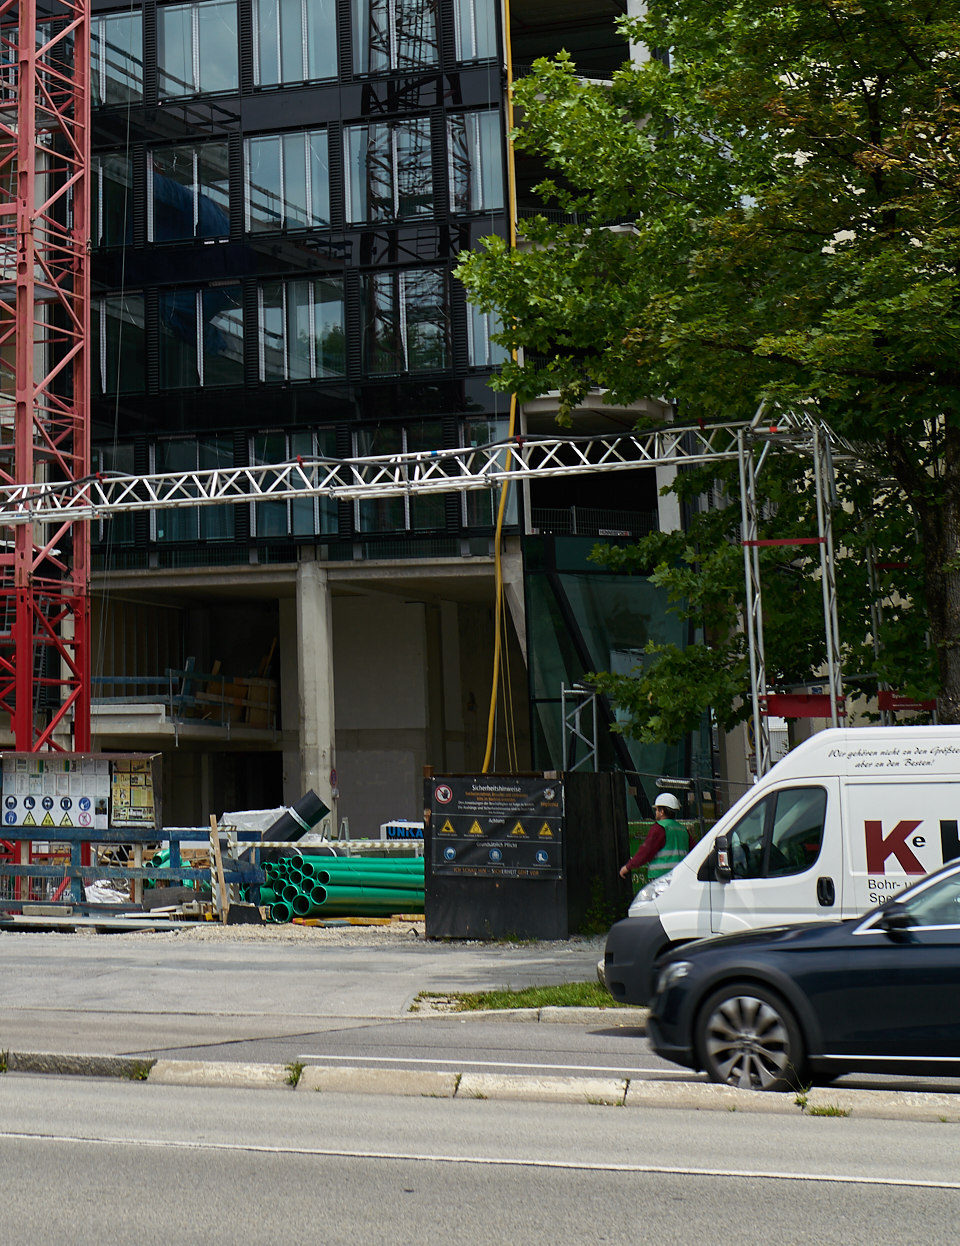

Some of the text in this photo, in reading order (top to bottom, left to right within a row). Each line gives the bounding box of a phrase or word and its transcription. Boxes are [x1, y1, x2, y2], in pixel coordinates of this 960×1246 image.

[828, 749, 846, 758] Wir
[847, 748, 878, 760] gehören
[880, 747, 901, 757] nicht
[914, 746, 928, 755] den
[855, 760, 873, 768] aber
[886, 759, 900, 768] den
[904, 758, 935, 767] Besten!
[471, 784, 522, 793] Sicherheitshinweise
[868, 879, 901, 890] Bohr-
